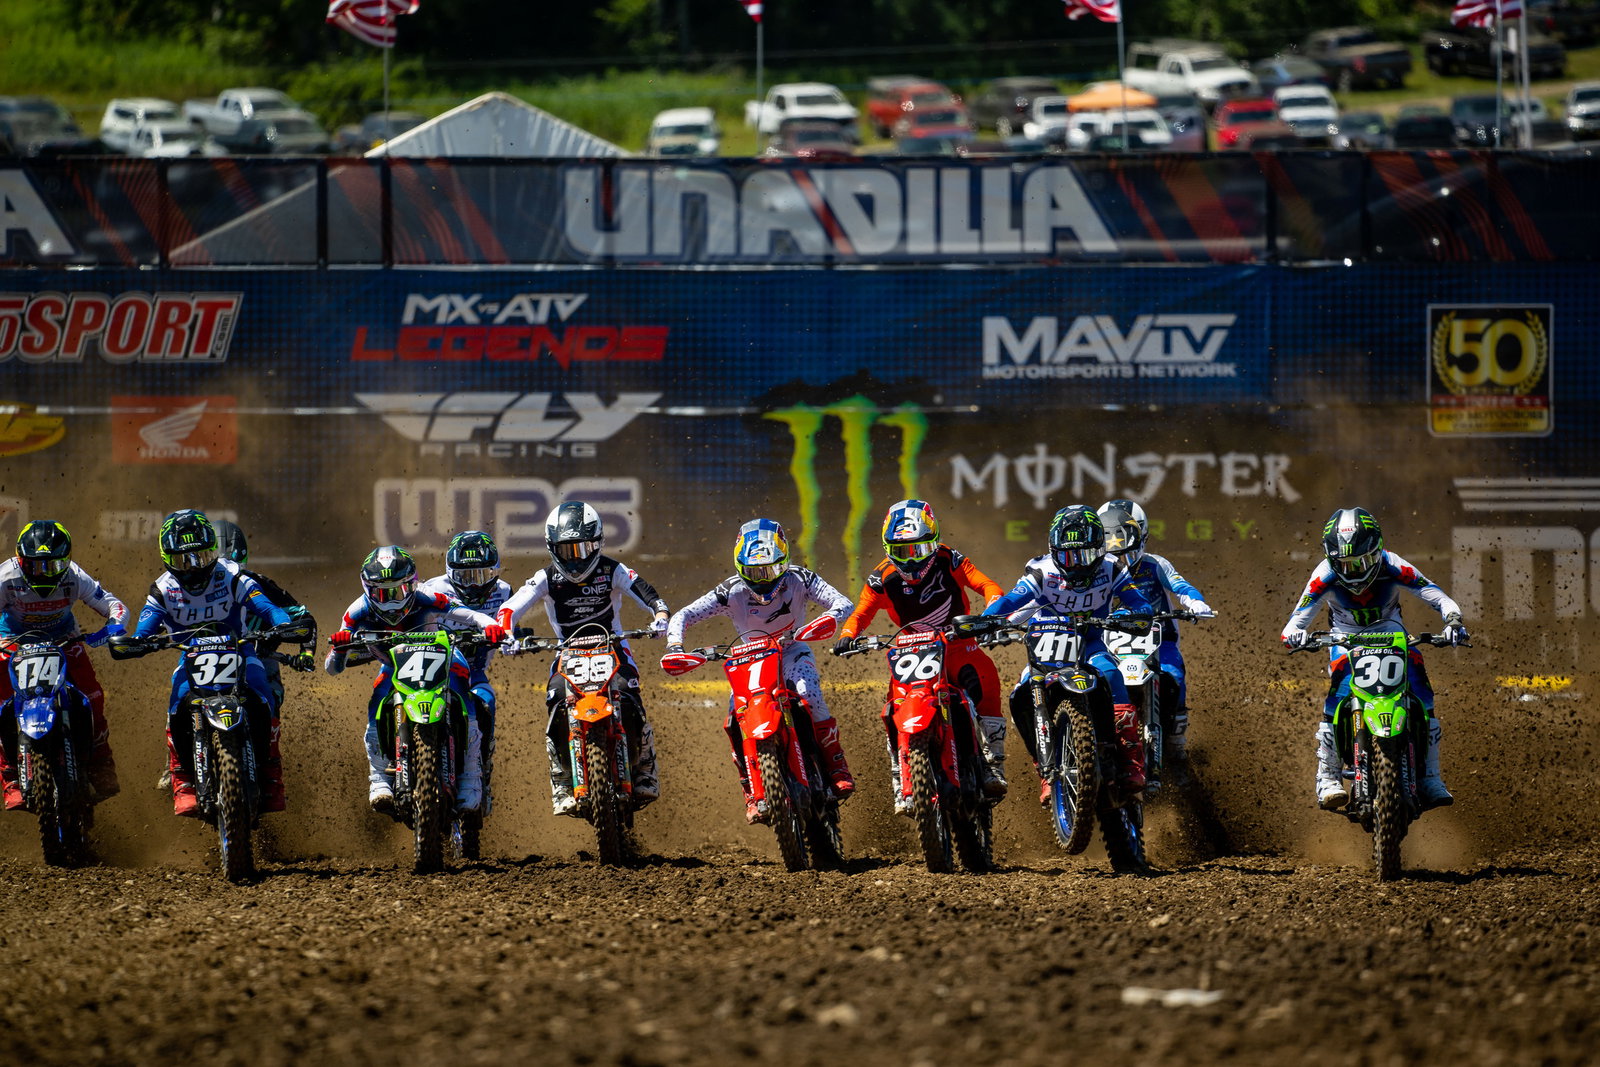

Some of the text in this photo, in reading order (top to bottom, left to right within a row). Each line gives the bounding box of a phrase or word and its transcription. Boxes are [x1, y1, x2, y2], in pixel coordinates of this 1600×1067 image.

[562, 166, 1120, 256] UNADILLA
[401, 293, 484, 325] MX
[492, 292, 589, 325] ATV
[350, 325, 671, 371] LEGENDS
[981, 314, 1239, 364] MAVTV
[1448, 318, 1538, 387] 50
[981, 362, 1238, 380] MOTORSPORTS NETWORK
[353, 391, 664, 442] FLY
[139, 447, 209, 459] HONDA
[419, 443, 598, 458] RACING
[950, 442, 1303, 511] MONSTER
[1004, 519, 1257, 543] ERGY
[200, 644, 218, 652] LUCAS
[734, 642, 767, 655] RENTHAL
[898, 636, 932, 645] RENTHAL
[1033, 631, 1082, 662] 411
[1109, 630, 1157, 654] 24
[1361, 648, 1382, 656] LUCAS
[15, 656, 61, 690] 174
[191, 653, 243, 686] 32
[397, 651, 447, 682] 47
[566, 654, 613, 685] 38
[747, 660, 766, 692] 1
[894, 652, 942, 684] 96
[1353, 655, 1405, 688] 30
[794, 740, 808, 782] DUNLOP
[950, 738, 960, 782] DUNLOP
